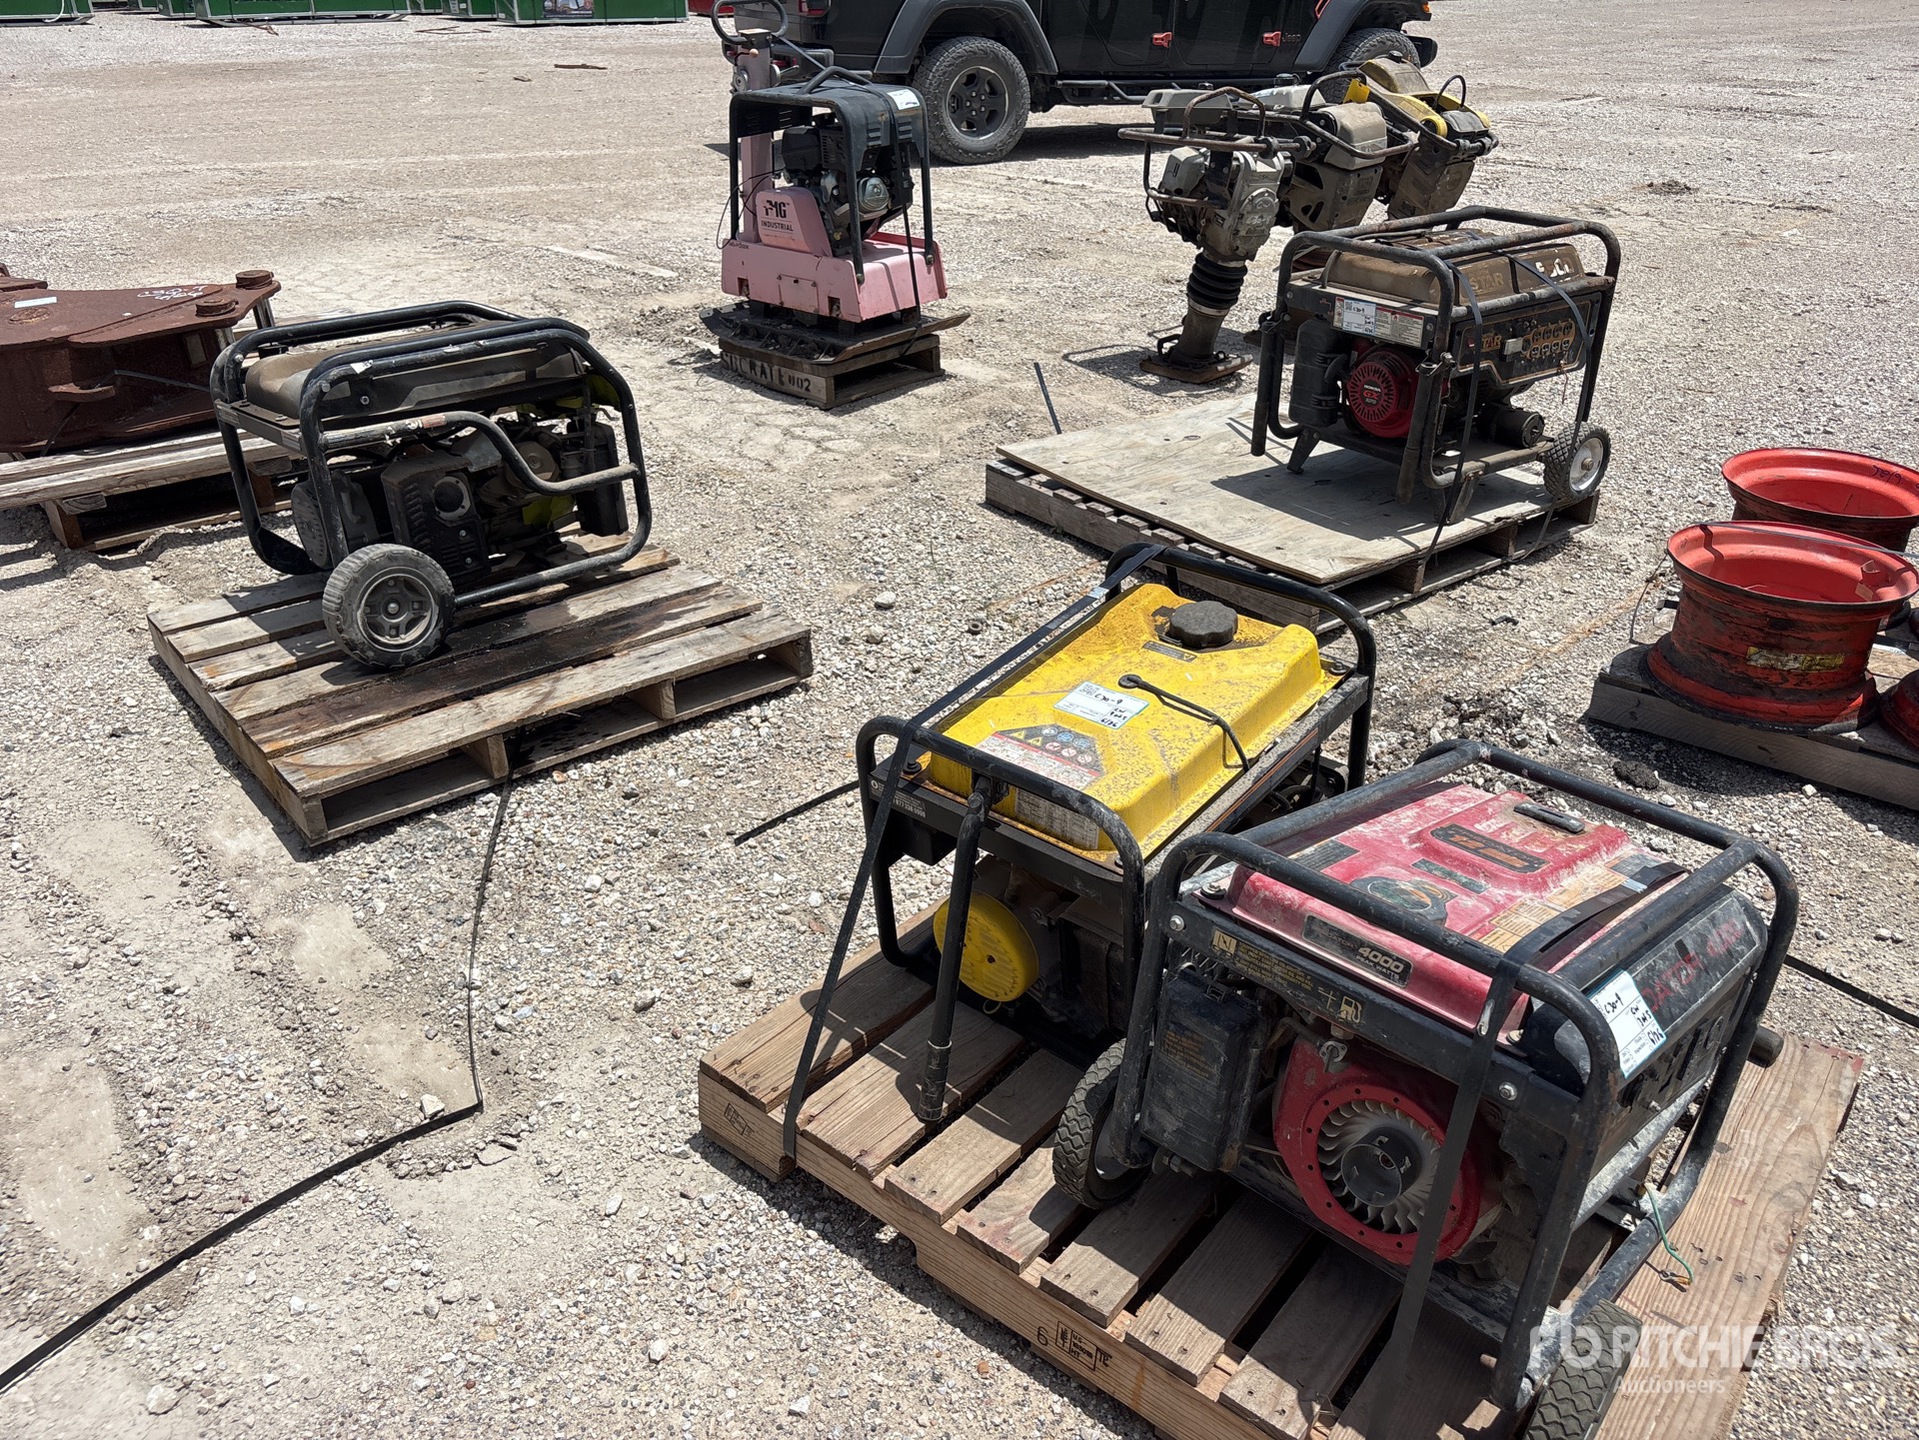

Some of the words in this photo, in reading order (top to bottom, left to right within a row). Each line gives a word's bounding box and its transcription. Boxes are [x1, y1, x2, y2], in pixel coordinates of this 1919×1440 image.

[761, 219, 794, 232] INDUSTRIAL
[1363, 390, 1381, 400] GX
[1356, 954, 1375, 967] PEAK
[1375, 964, 1400, 980] WATTS
[1358, 946, 1404, 973] 4000
[1037, 1325, 1048, 1347] 6
